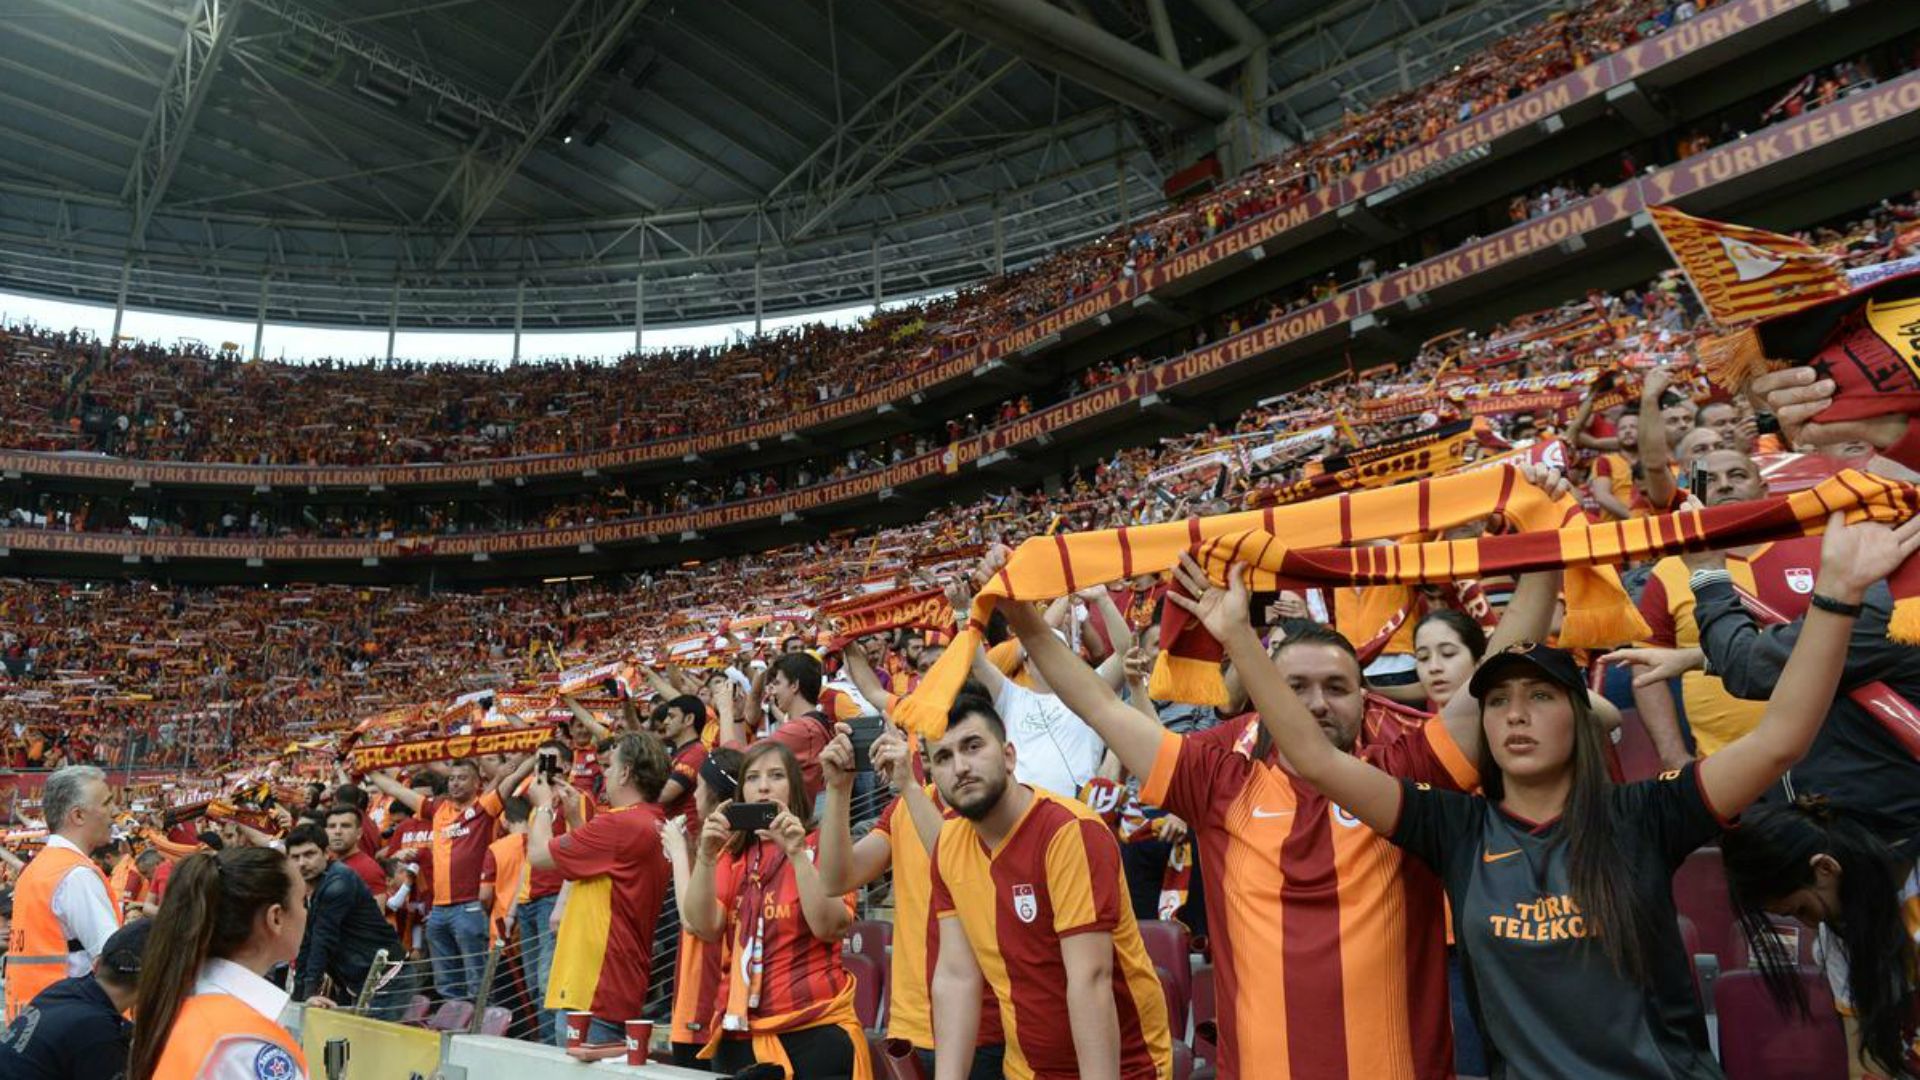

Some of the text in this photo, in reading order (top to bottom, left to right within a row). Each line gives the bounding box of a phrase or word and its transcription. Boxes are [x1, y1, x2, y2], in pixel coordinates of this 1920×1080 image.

[1657, 5, 1748, 60] TÜRK
[1376, 84, 1572, 187] TÜRK TELEKOM
[1690, 81, 1920, 190] TÜRK TELEKO
[1161, 203, 1310, 283] TÜRK TELEKOM
[1393, 205, 1597, 297] TÜRK TELEKOM
[996, 291, 1111, 352] TÜRK TELEKOM
[1172, 308, 1325, 380] TÜRK TELEKOM
[882, 354, 976, 405] TÜRK TELEKOM
[692, 420, 788, 452] TÜRK TELEKOM
[788, 396, 881, 430] TÜRK TELEKOM
[1002, 388, 1120, 444] TÜRK TELEKOM
[590, 441, 689, 468] TÜRK TELEKOM
[884, 441, 981, 487] TÜRK TELOM
[689, 497, 788, 529] TÜRK TELEKOM
[788, 476, 882, 509] TÜRK TELEKOM
[371, 541, 400, 558] TÜR
[587, 514, 687, 543] TÜRK TELEKOM
[1490, 915, 1592, 941] TELEKO
[1515, 895, 1582, 922] TÜRK
